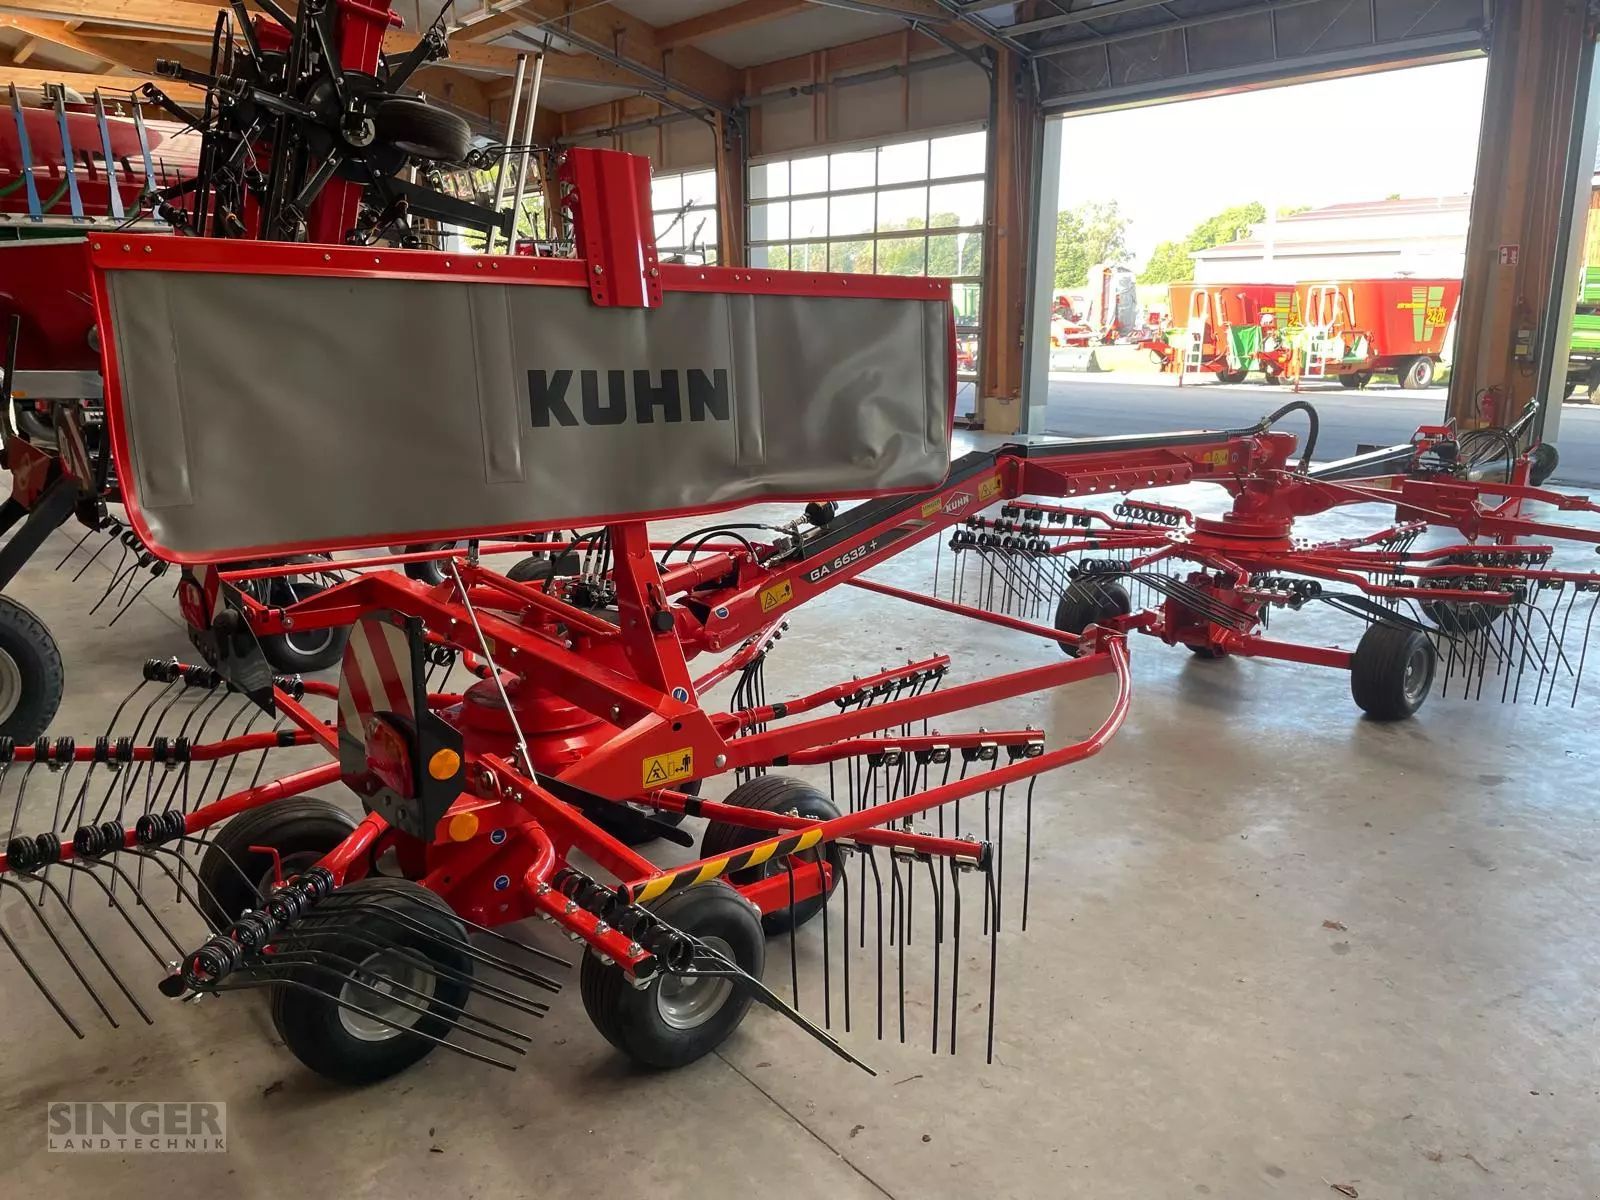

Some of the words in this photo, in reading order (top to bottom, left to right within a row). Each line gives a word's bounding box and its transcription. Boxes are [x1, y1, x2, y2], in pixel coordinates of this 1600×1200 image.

[527, 368, 730, 428] KUHN
[945, 495, 970, 513] KUHN
[810, 564, 831, 581] GA
[833, 545, 867, 569] 6632
[870, 540, 878, 550] +
